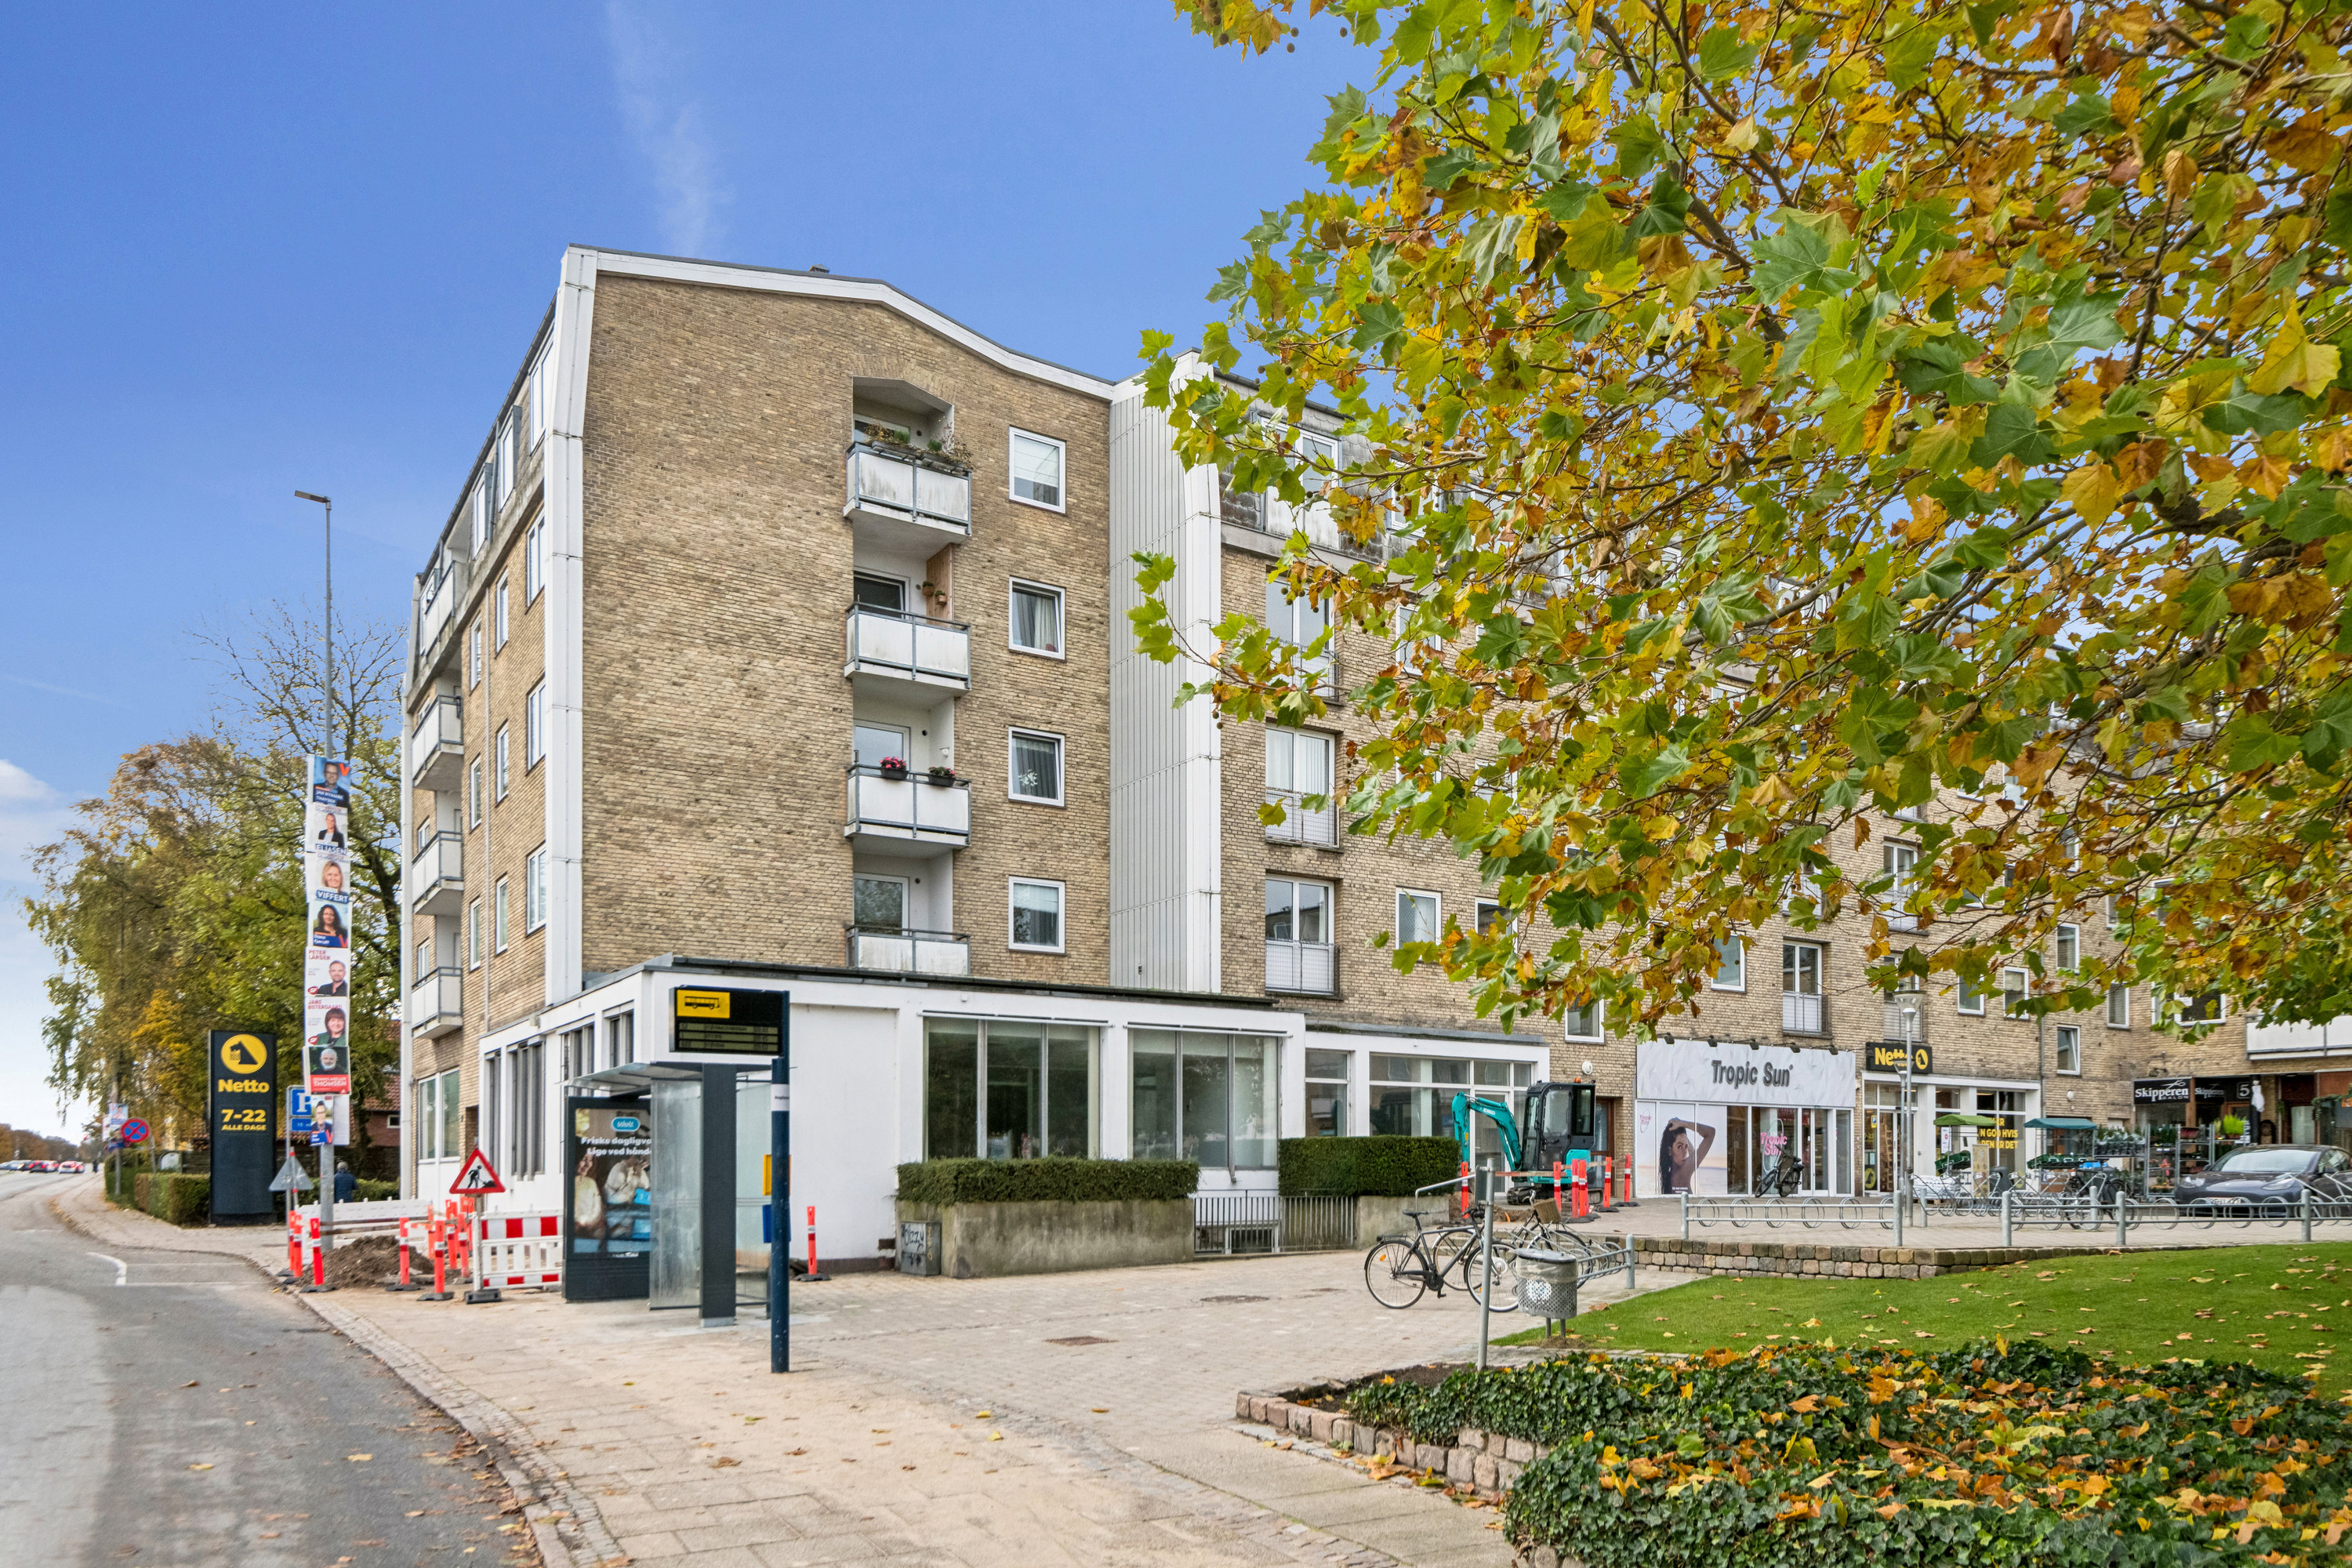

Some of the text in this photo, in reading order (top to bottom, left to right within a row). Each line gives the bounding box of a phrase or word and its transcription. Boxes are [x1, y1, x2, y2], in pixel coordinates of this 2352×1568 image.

[317, 844, 348, 855] ELIASEN
[318, 891, 349, 902] VIFFERT
[1875, 1047, 1913, 1067] Nett
[1711, 1060, 1791, 1089] Tropic Sun
[218, 1079, 270, 1094] Netto
[2239, 1084, 2250, 1097] 5
[2135, 1087, 2189, 1102] Skipperen
[221, 1109, 267, 1123] 7-22
[1760, 1132, 1788, 1145] Tropic
[1987, 1129, 2002, 1138] GOD
[2002, 1129, 2019, 1138] HVIS
[581, 1136, 611, 1145] Friske
[2005, 1140, 2019, 1149] DET
[586, 1147, 608, 1156] Lige
